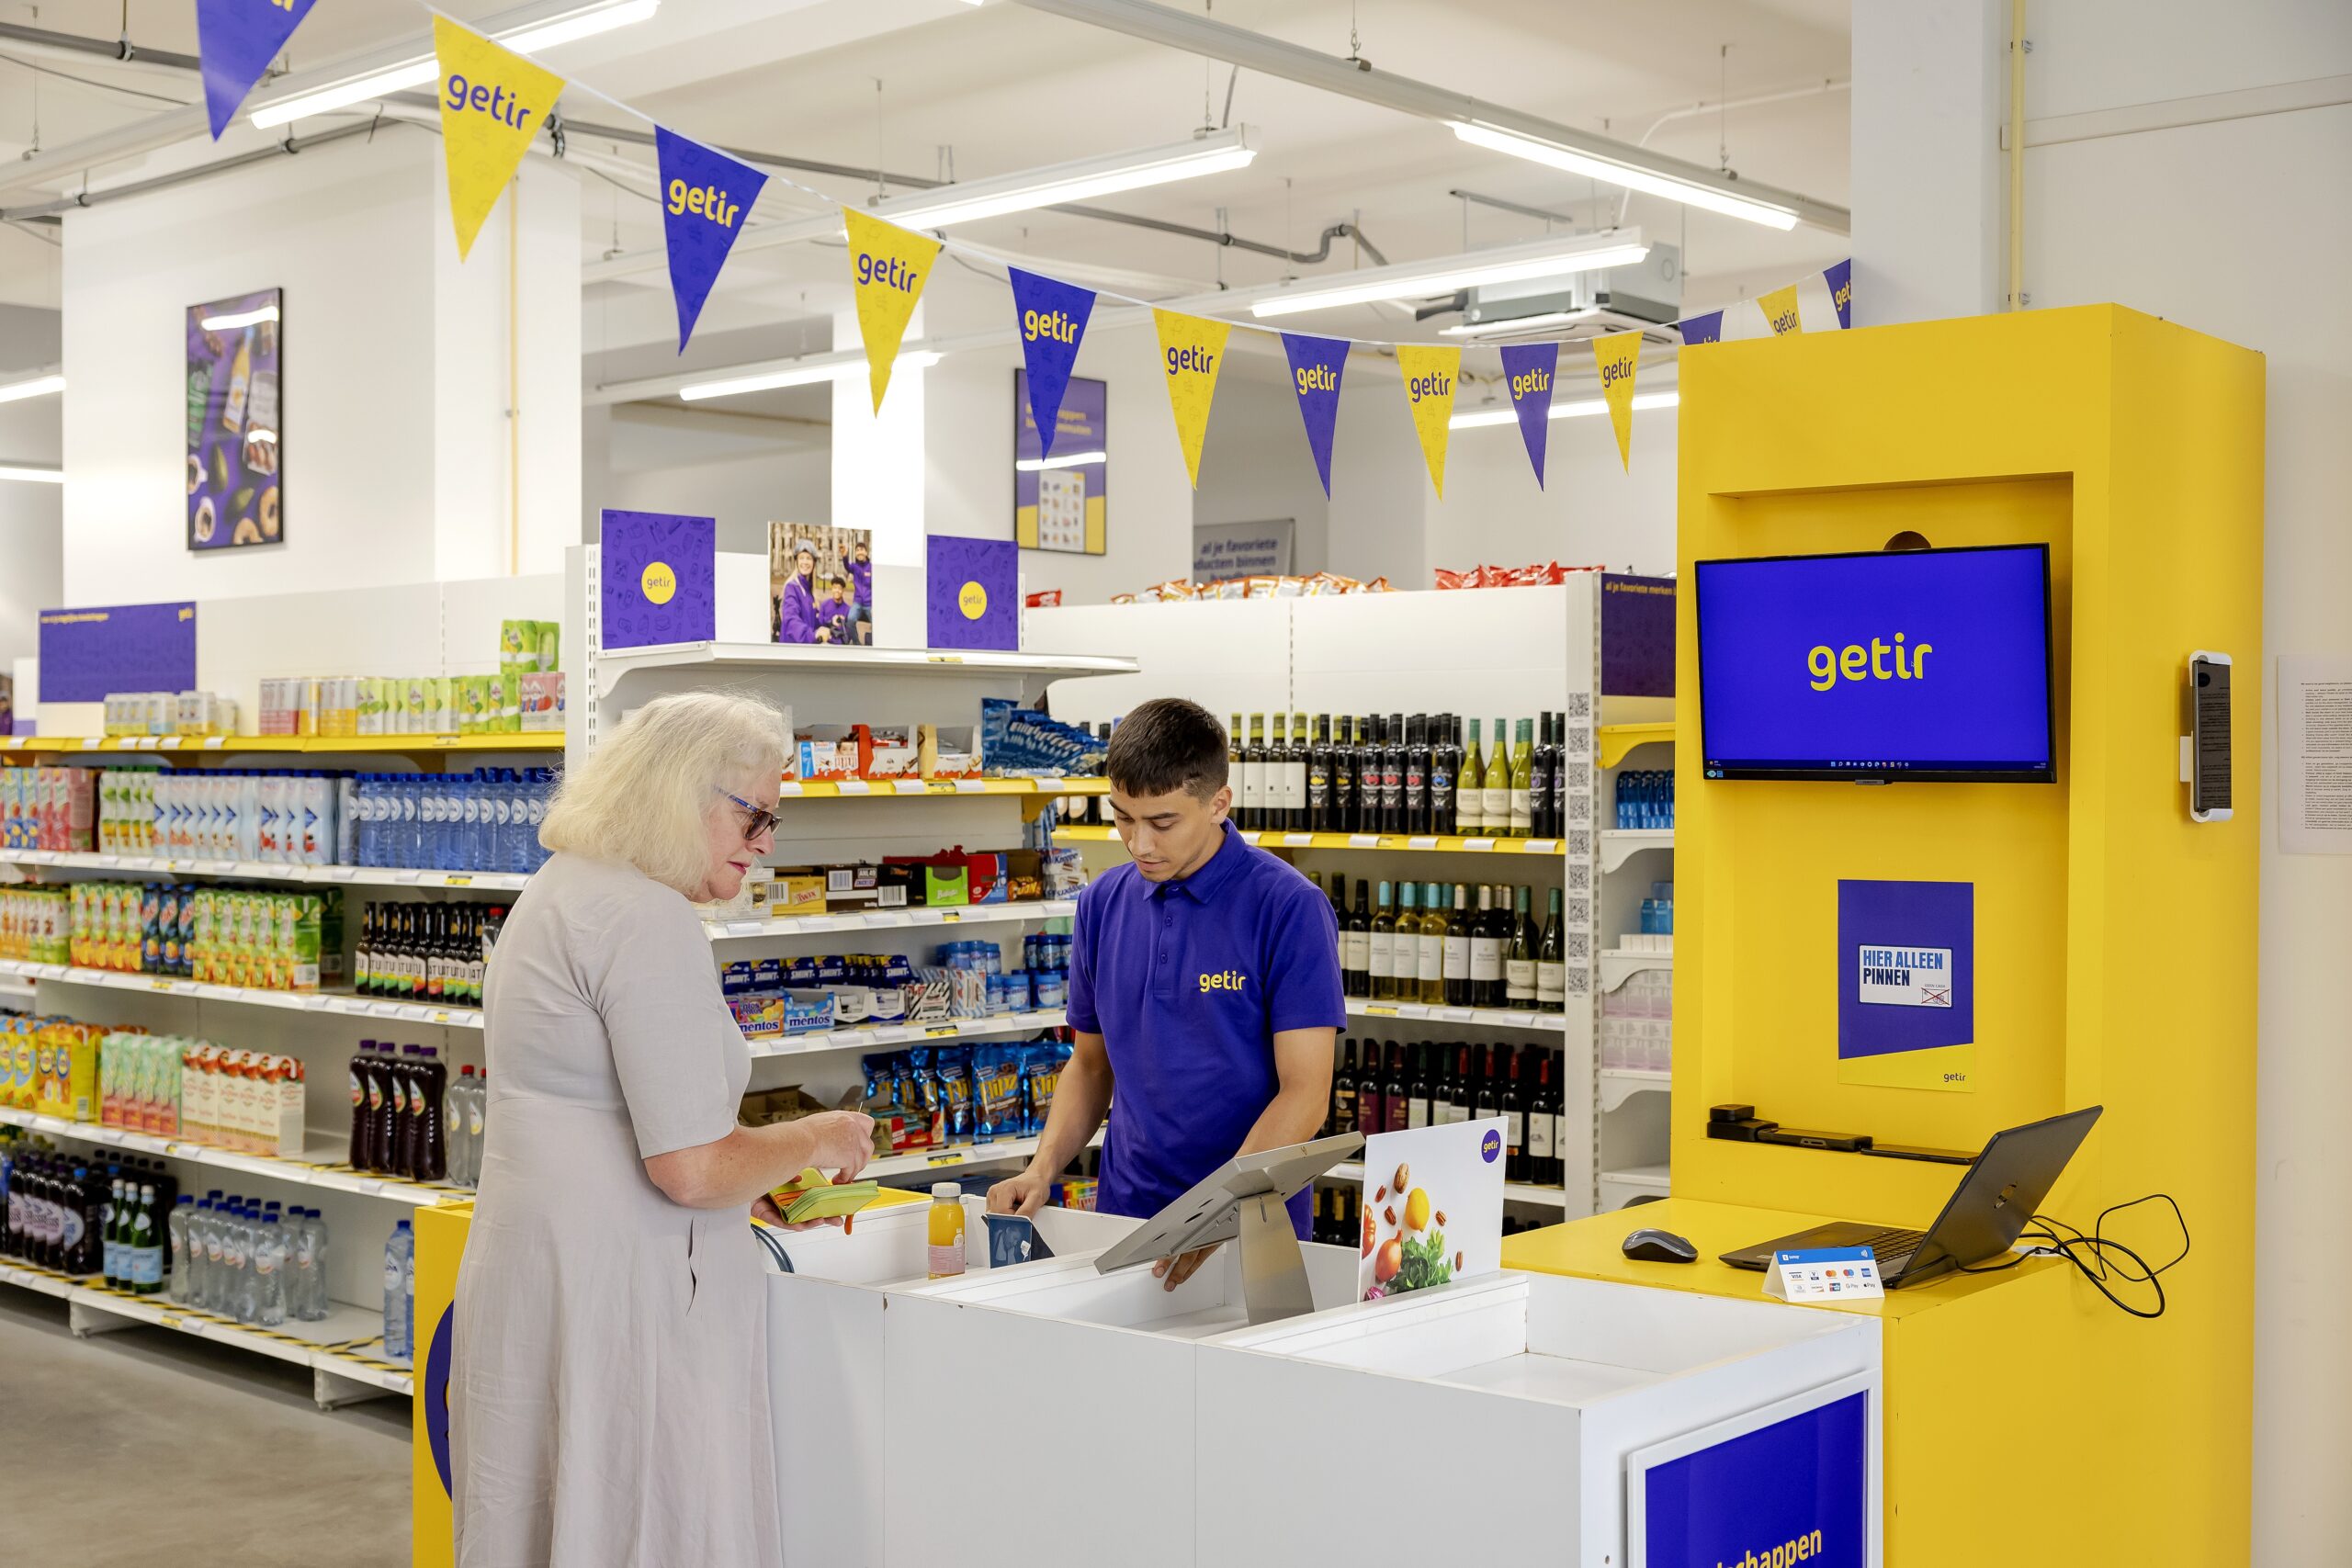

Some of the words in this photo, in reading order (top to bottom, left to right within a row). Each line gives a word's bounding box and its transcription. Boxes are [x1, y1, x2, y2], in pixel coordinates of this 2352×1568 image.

[446, 73, 531, 130] getir
[667, 179, 739, 228] getir
[857, 253, 918, 293] getir
[1024, 310, 1079, 344] getir
[1772, 310, 1797, 335] getir
[1166, 344, 1214, 376] getir
[1602, 356, 1633, 389] getir
[1295, 364, 1337, 396] getir
[1409, 372, 1451, 403] getir
[1512, 368, 1550, 400] getir
[647, 574, 671, 590] getir
[963, 593, 984, 606] getir
[1807, 632, 1933, 692] getir
[1862, 950, 1893, 967] HIER
[1895, 951, 1943, 969] ALLEEN
[1199, 970, 1246, 993] getir
[1862, 968, 1910, 986] PINNEN
[739, 1021, 779, 1032] mentos
[789, 1015, 831, 1028] mentos
[1943, 1072, 1966, 1083] getir
[1483, 1140, 1499, 1154] getir
